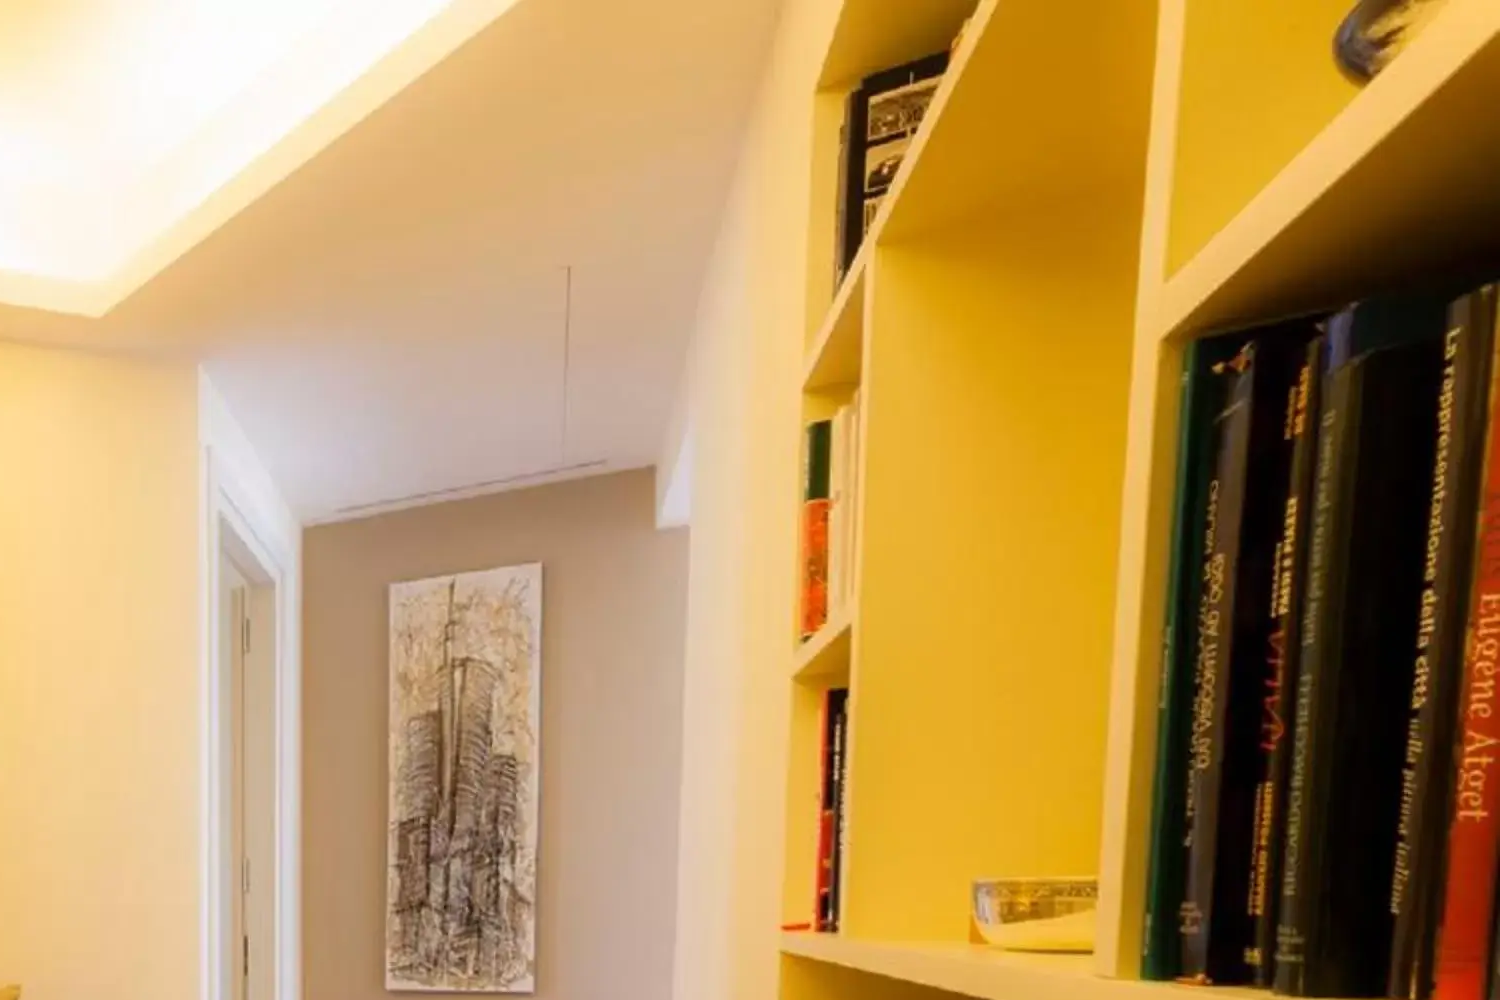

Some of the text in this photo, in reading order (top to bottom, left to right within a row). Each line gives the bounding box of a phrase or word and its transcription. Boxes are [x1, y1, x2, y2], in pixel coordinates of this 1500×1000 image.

[1445, 326, 1463, 360] La
[1415, 587, 1440, 649] della
[1456, 729, 1500, 822] Atget
